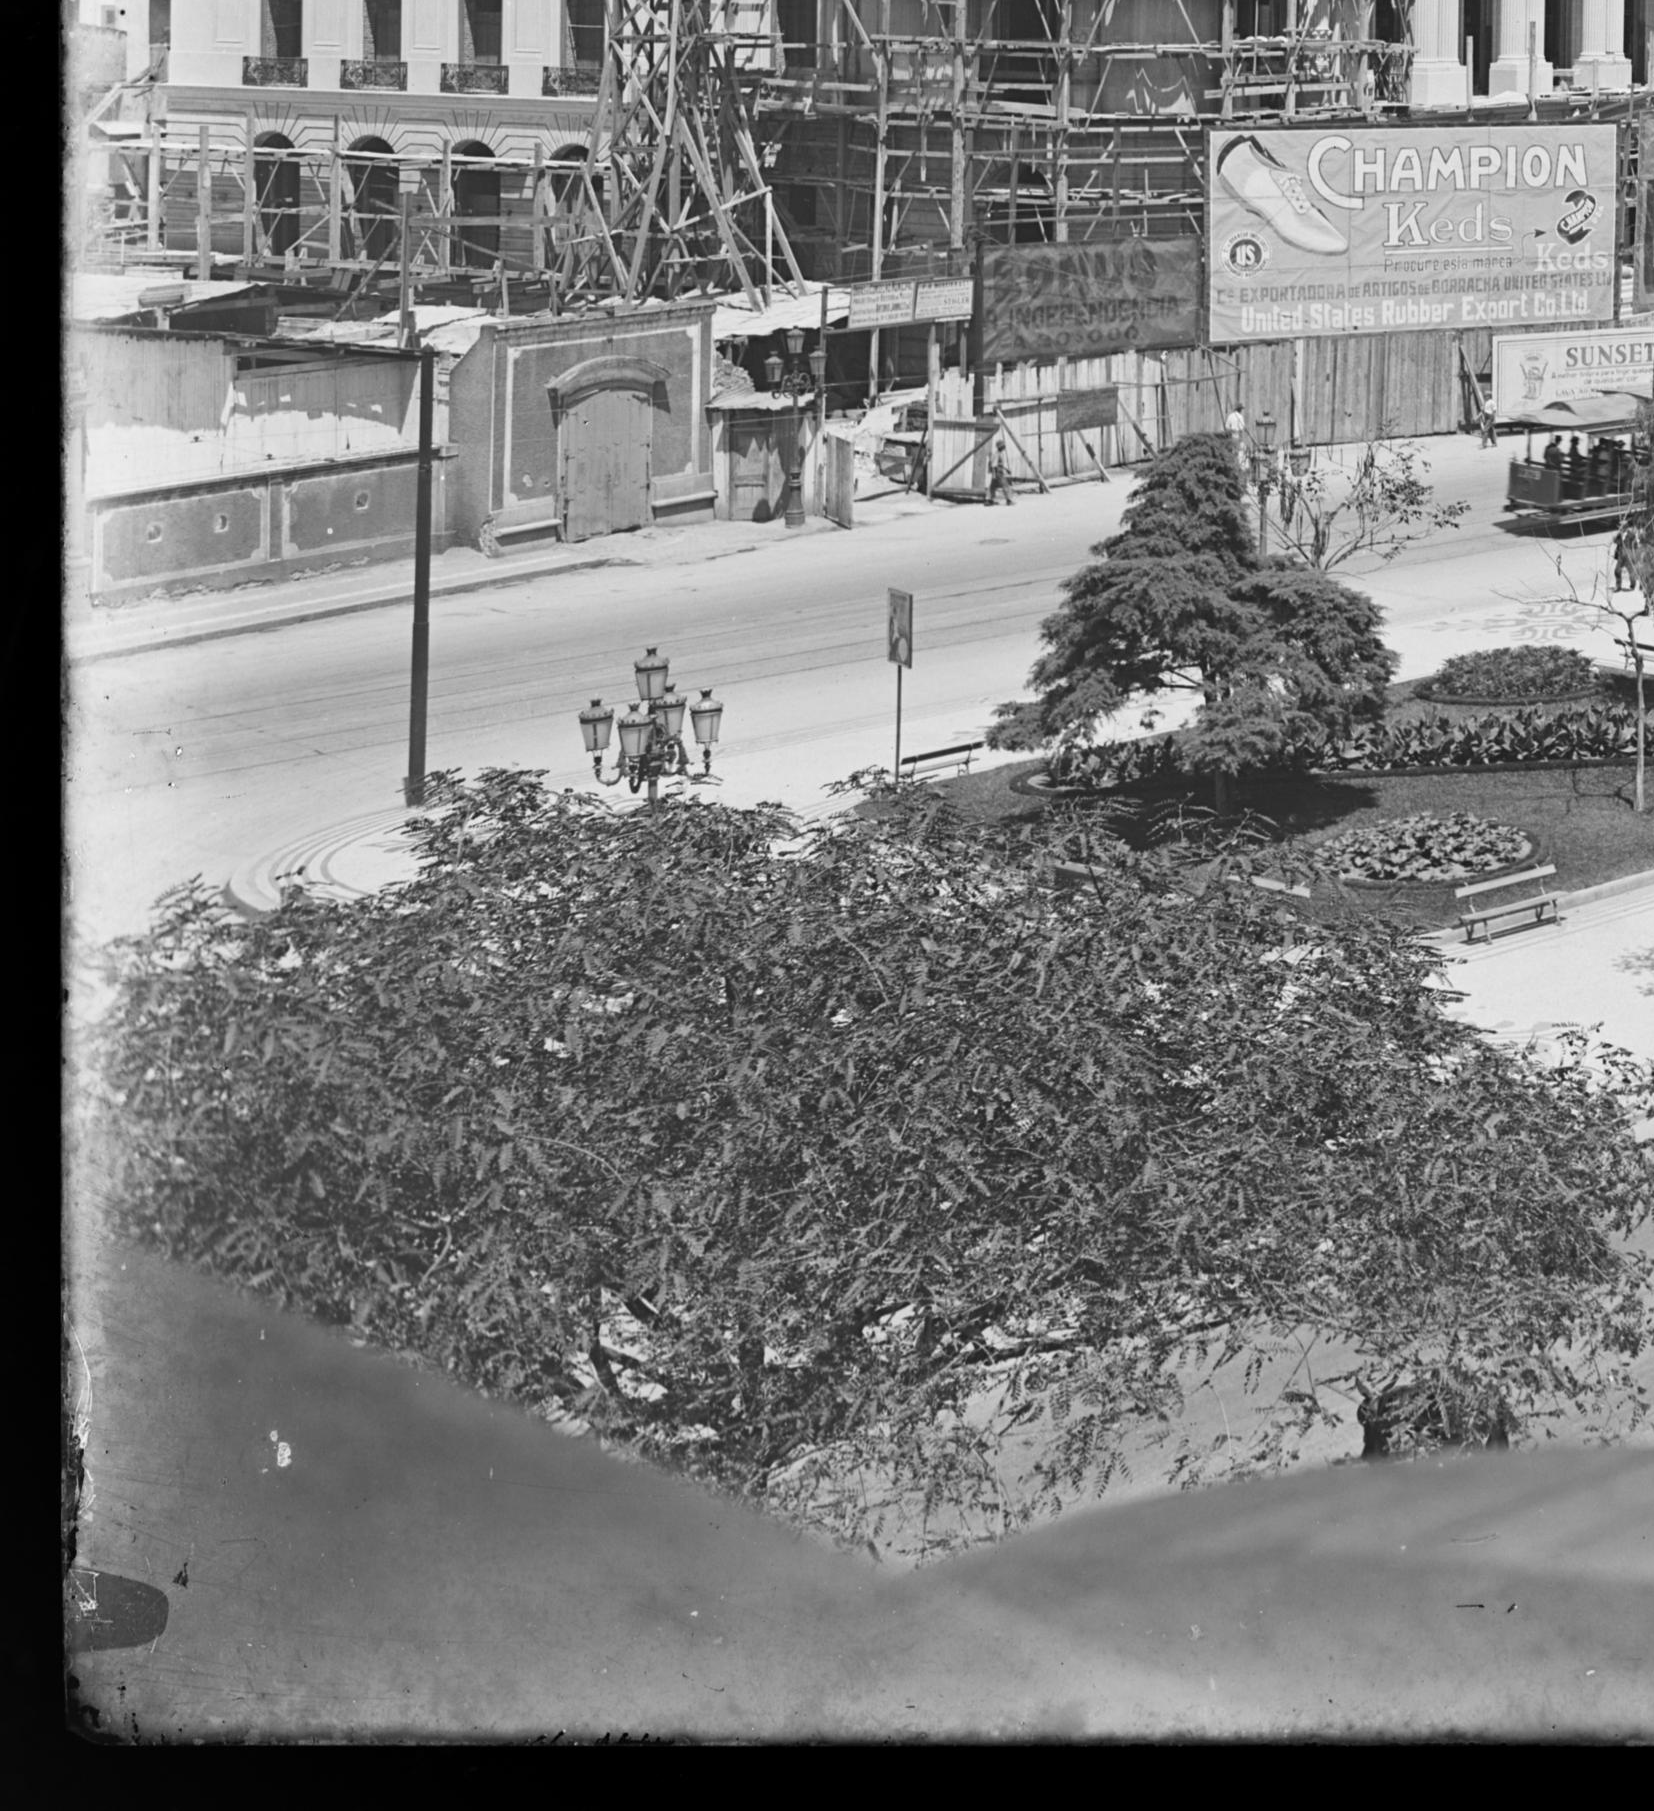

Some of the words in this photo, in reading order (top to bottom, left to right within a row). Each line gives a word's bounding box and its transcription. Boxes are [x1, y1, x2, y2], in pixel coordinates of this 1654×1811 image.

[1307, 135, 1589, 210] CHAMPION
[1383, 201, 1513, 248] Keds
[1384, 258, 1439, 272] Procure
[1472, 256, 1513, 269] marca
[1535, 240, 1609, 272] Keds
[1239, 283, 1345, 304] EXPORTADORA
[1362, 280, 1418, 298] ARTIGOS
[1431, 276, 1500, 295] BORRACHA
[1504, 273, 1547, 290] UNITED
[1549, 271, 1593, 288] STATES
[1240, 305, 1303, 333] United
[1309, 302, 1375, 329] States
[1382, 299, 1455, 326] Rubber
[1461, 292, 1529, 322] Export
